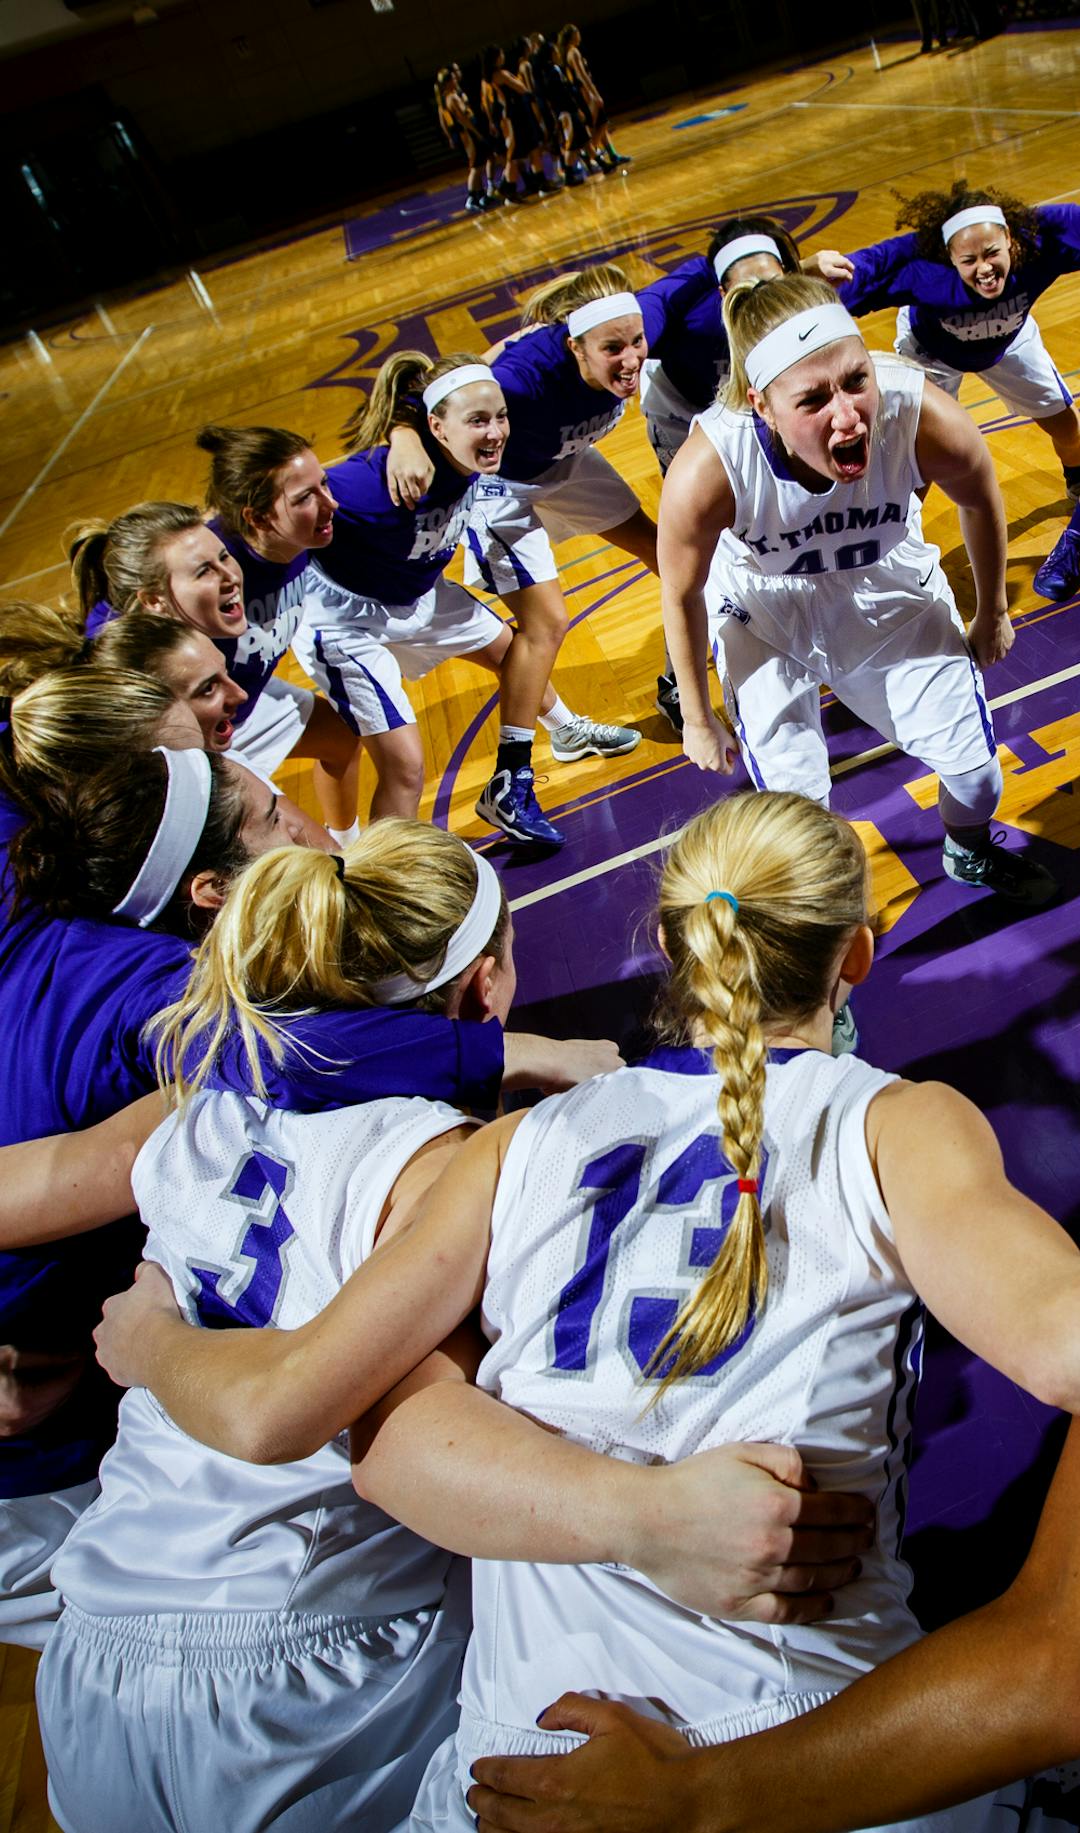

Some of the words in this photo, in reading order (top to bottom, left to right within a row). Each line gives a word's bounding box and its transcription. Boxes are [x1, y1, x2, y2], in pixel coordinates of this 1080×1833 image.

[407, 510, 471, 560] PRID
[779, 502, 910, 550] THOMA
[781, 539, 881, 575] 40
[233, 604, 304, 665] PRID
[186, 1141, 300, 1329] 3
[536, 1126, 780, 1388] 13
